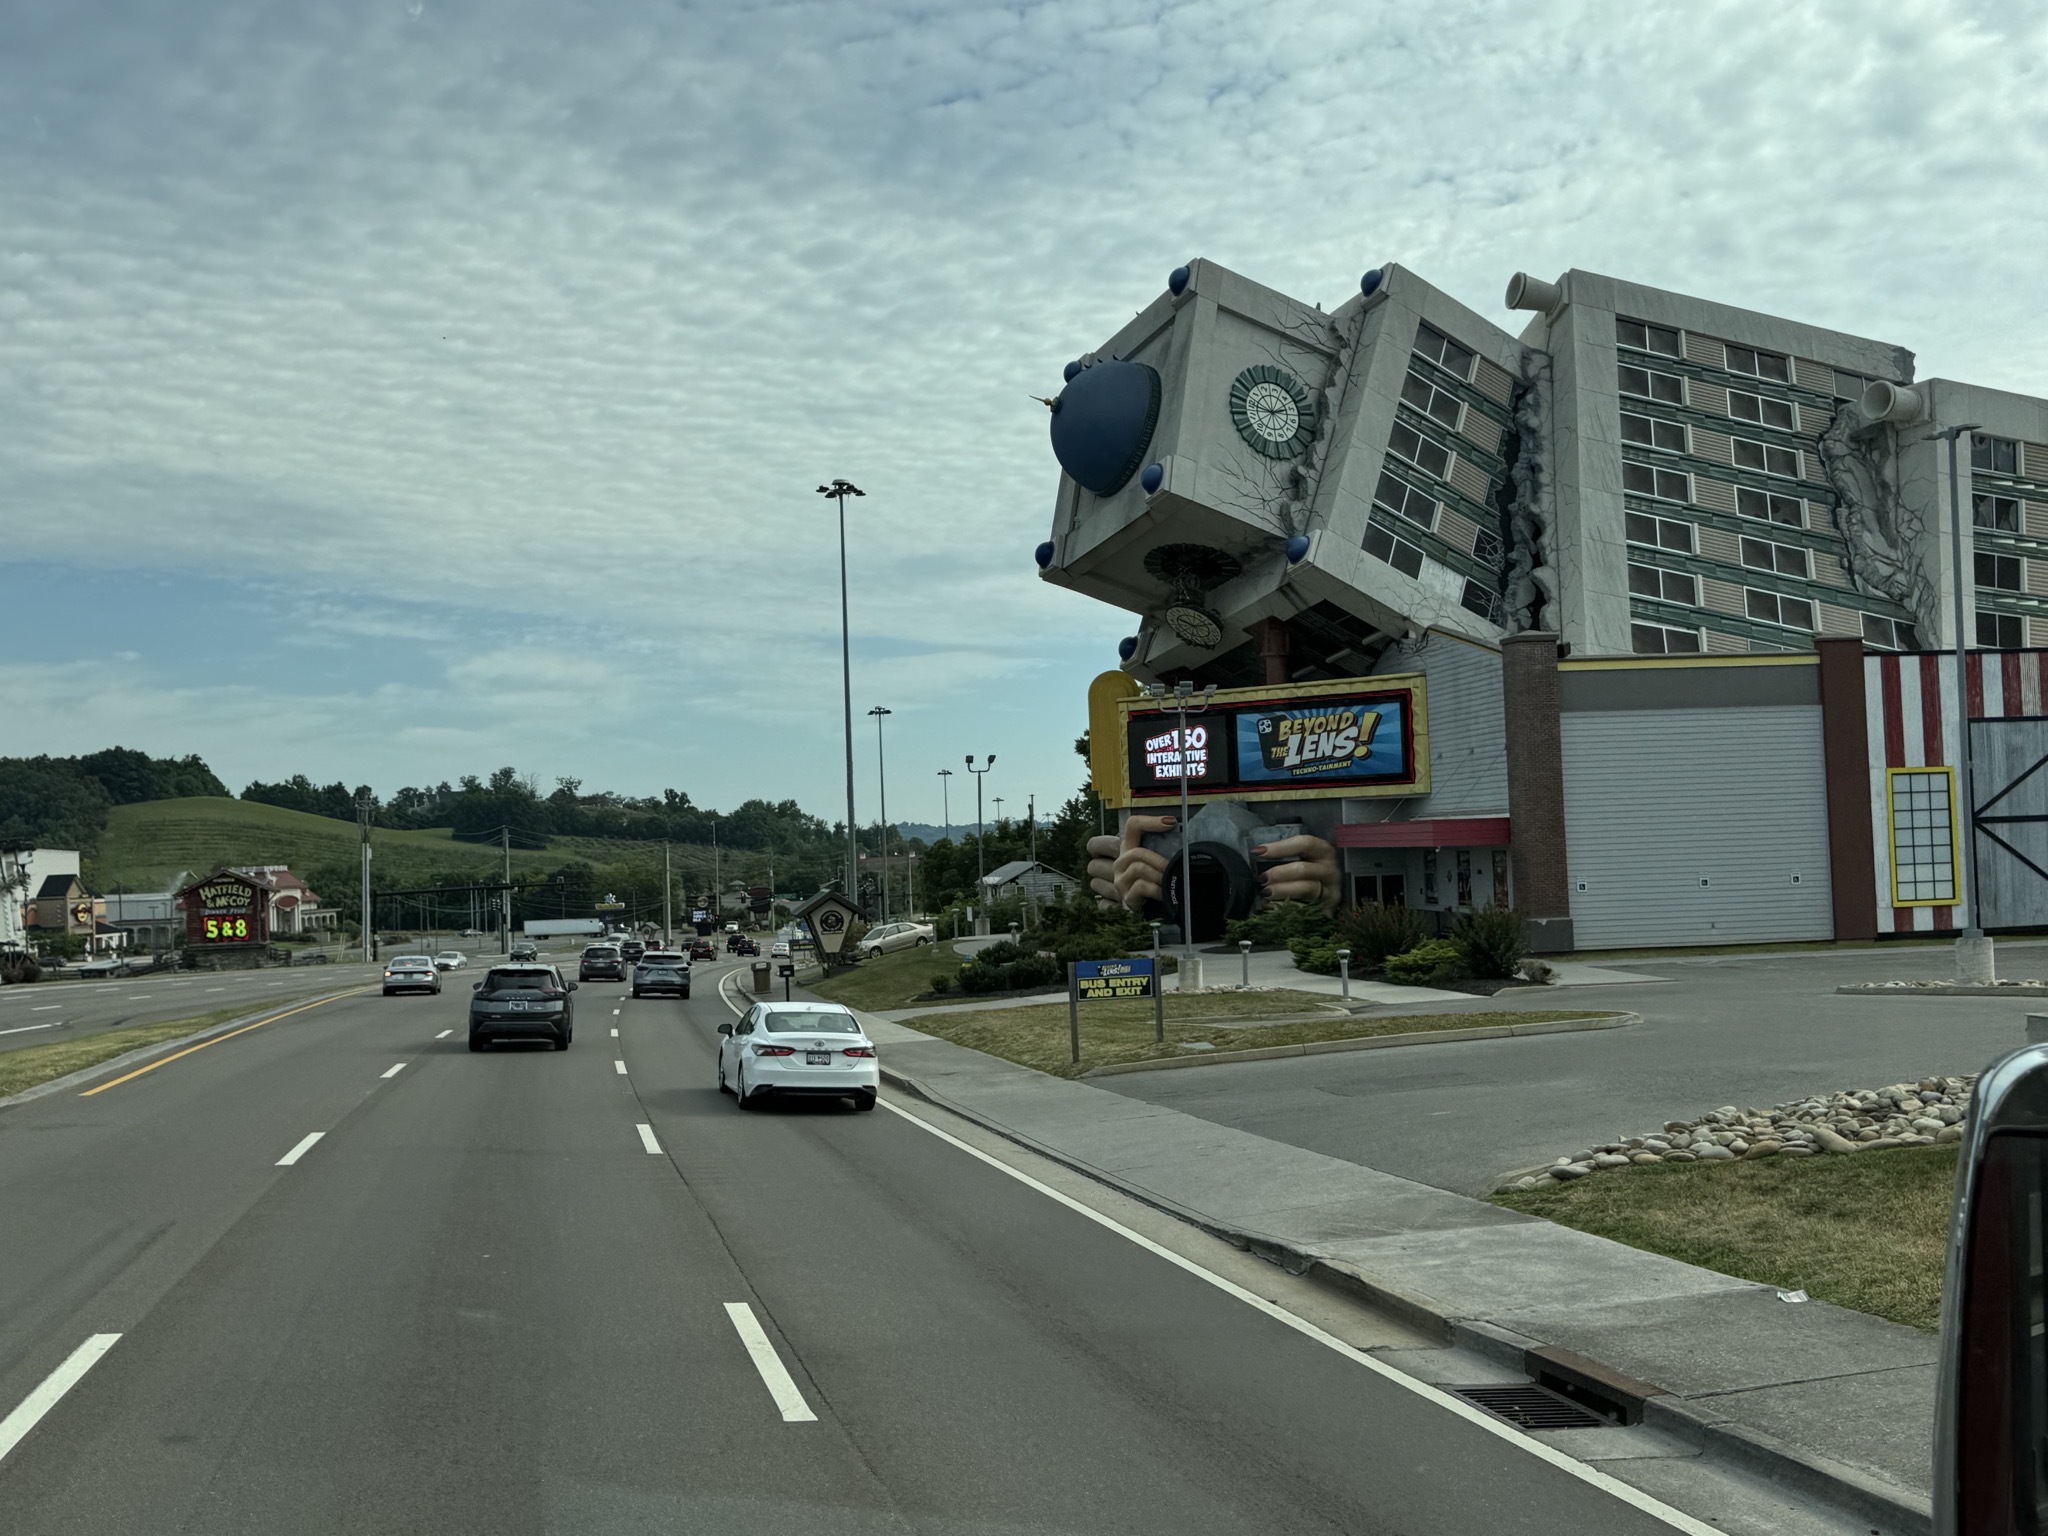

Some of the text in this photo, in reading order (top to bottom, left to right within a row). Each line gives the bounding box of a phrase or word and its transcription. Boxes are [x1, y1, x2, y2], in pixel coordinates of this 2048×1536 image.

[1278, 711, 1354, 742] BEYOND
[1145, 734, 1172, 752] OVER
[1271, 711, 1379, 768] THE LENS!
[1147, 749, 1207, 765] INTERATIVE
[199, 885, 252, 901] HATFIELD
[206, 899, 215, 908] &
[206, 919, 247, 938] 5 & 8
[1080, 977, 1148, 989] BUS ENTRY
[1086, 987, 1143, 998] AND EXIT
